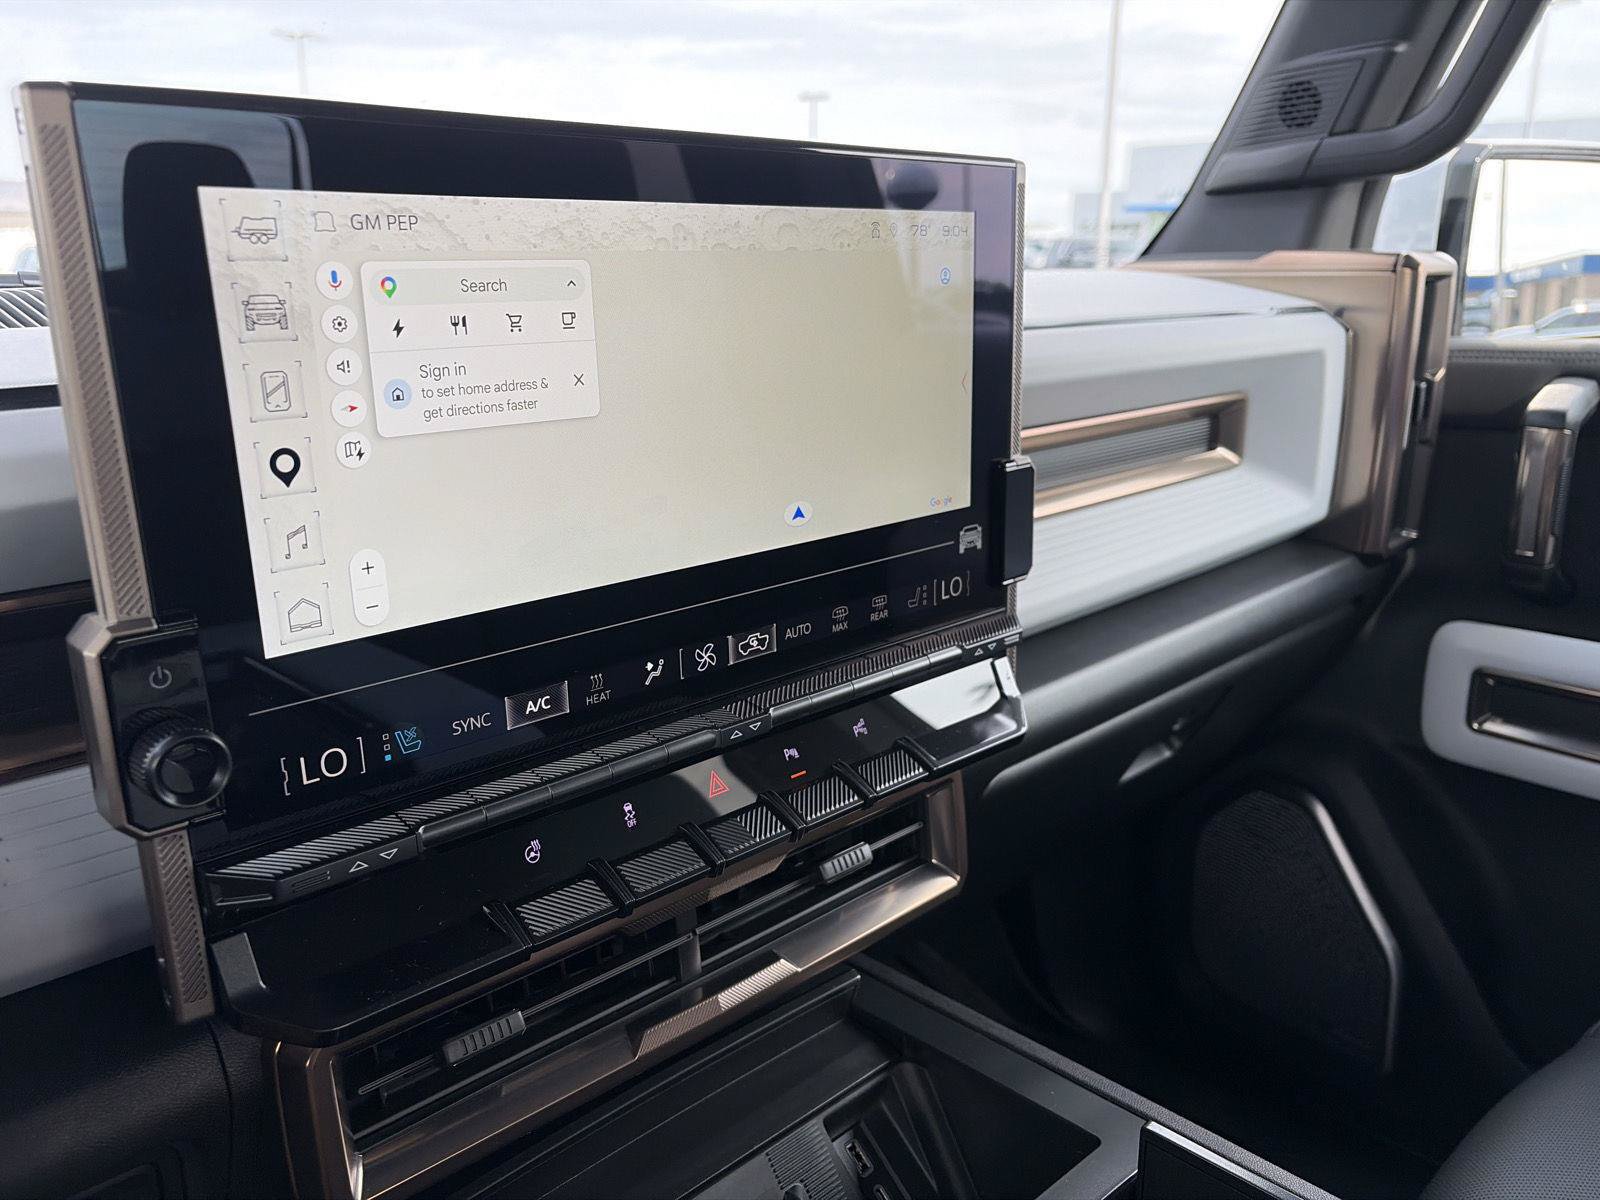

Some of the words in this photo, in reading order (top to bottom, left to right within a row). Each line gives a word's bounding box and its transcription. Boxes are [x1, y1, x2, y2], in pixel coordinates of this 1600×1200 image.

[350, 213, 382, 231] GM
[386, 214, 419, 231] PEP
[460, 278, 508, 293] Search
[419, 363, 451, 381] Sign
[454, 361, 467, 376] in
[421, 387, 434, 399] to
[437, 385, 456, 398] set
[458, 384, 491, 396] home
[493, 379, 538, 393] address
[540, 377, 549, 389] &
[423, 408, 444, 423] get
[446, 401, 504, 418] directions
[507, 399, 538, 412] faster
[941, 576, 963, 600] LO
[870, 609, 889, 622] REAR
[784, 622, 812, 640] AUTO
[832, 621, 849, 633] MAX
[525, 695, 551, 715] A/C
[586, 689, 612, 706] HEAT
[452, 712, 492, 736] SYNC
[300, 747, 348, 786] LO
